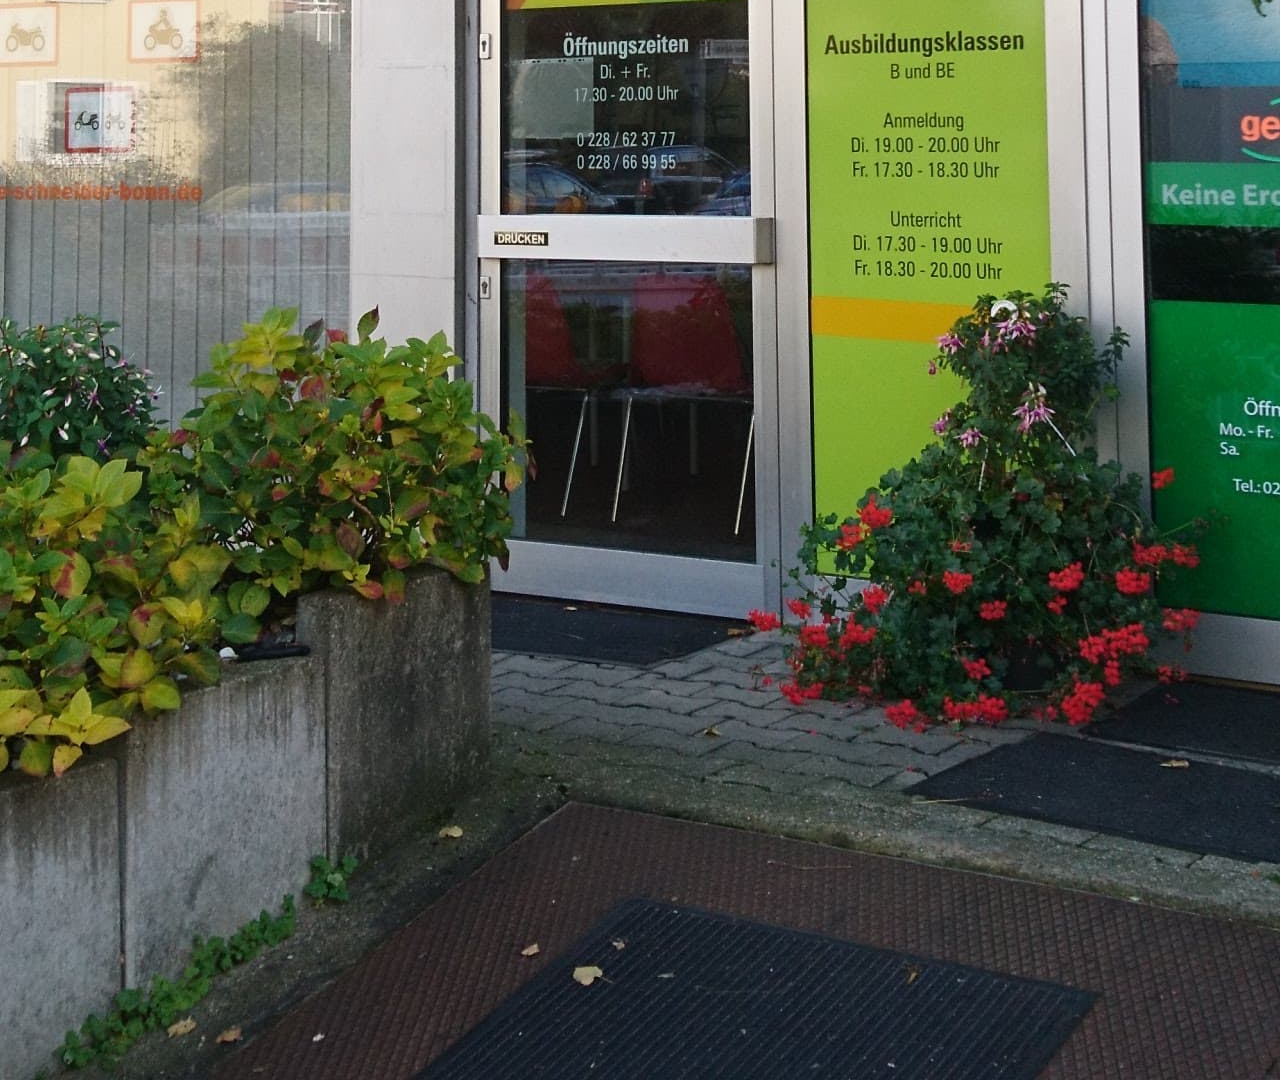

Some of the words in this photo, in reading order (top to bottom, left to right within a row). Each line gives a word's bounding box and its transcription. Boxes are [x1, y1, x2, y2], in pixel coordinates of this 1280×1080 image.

[563, 32, 689, 59] Öffnungszeiten
[824, 30, 1025, 58] Ausbildungsklassen
[600, 64, 616, 80] Di.
[621, 67, 632, 78] +
[637, 64, 651, 79] Fr.
[891, 65, 900, 79] B
[905, 63, 931, 79] und
[936, 63, 955, 78] BE
[575, 87, 607, 103] 17.30
[619, 86, 653, 102] 20.00
[657, 86, 679, 102] Uhr
[883, 112, 964, 131] Anmeldung
[576, 133, 584, 147] 0
[588, 132, 610, 147] 228
[622, 132, 638, 146] 62
[641, 132, 657, 146] 37
[660, 131, 675, 146] 77
[851, 138, 869, 153] Di.
[875, 137, 914, 153] 19.00
[928, 137, 969, 153] 20.00
[973, 137, 1000, 153] Uhr
[576, 155, 584, 169] 0
[588, 155, 610, 169] 228
[622, 155, 638, 169] 66
[641, 154, 657, 169] 99
[660, 154, 676, 169] 55
[852, 162, 869, 178] Fr.
[874, 162, 913, 178] 17.30
[928, 162, 969, 178] 18.30
[974, 162, 1000, 178] Uhr
[1161, 183, 1236, 206] Keine
[890, 211, 962, 228] Unterricht
[853, 236, 871, 252] Di.
[876, 236, 916, 252] 17.30
[931, 237, 972, 254] 19.00
[976, 238, 1003, 254] Uhr
[854, 260, 871, 276] Fr.
[876, 261, 916, 277] 18.30
[930, 262, 971, 279] 20.00
[975, 263, 1002, 279] Uhr
[1219, 422, 1246, 438] Mo.
[1256, 425, 1274, 439] Fr.
[1220, 442, 1240, 457] Sa.
